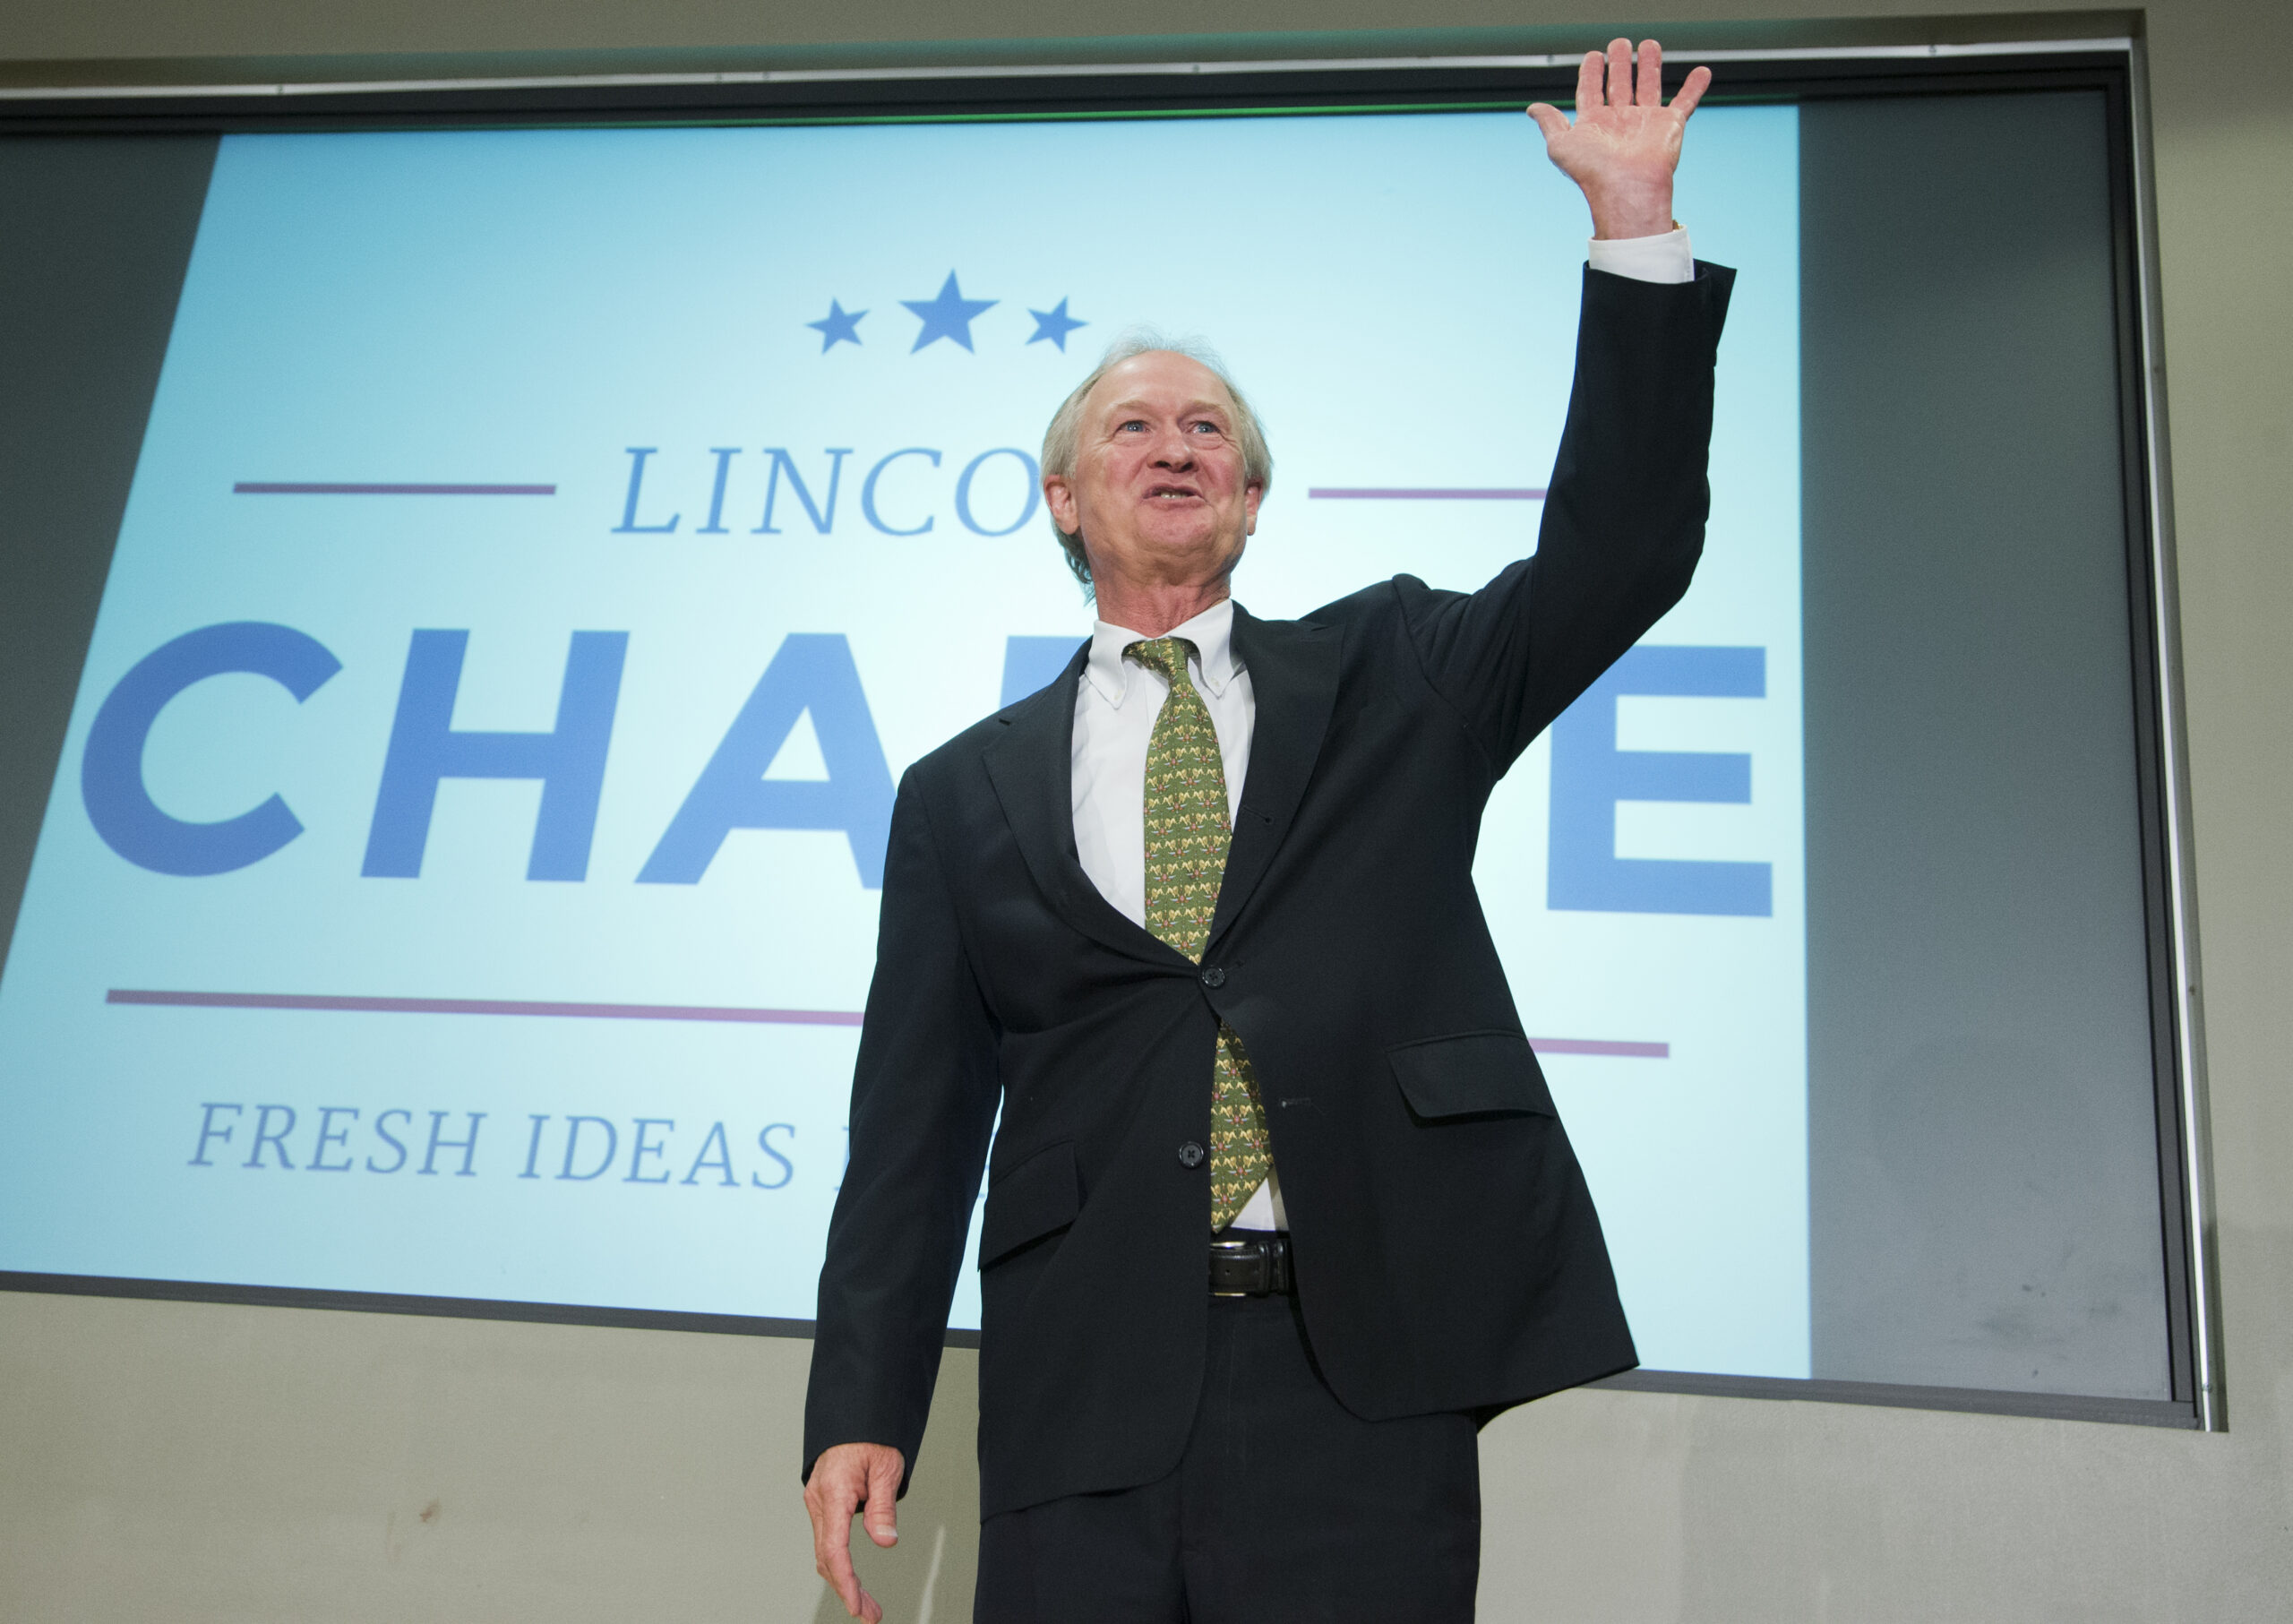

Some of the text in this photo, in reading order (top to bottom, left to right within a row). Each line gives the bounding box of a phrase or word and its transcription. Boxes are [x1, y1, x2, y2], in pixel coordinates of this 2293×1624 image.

[611, 446, 1042, 537] LINCO
[81, 620, 1773, 918] CHAE
[186, 1102, 489, 1178] FRESH
[517, 1113, 796, 1190] IDEAS
